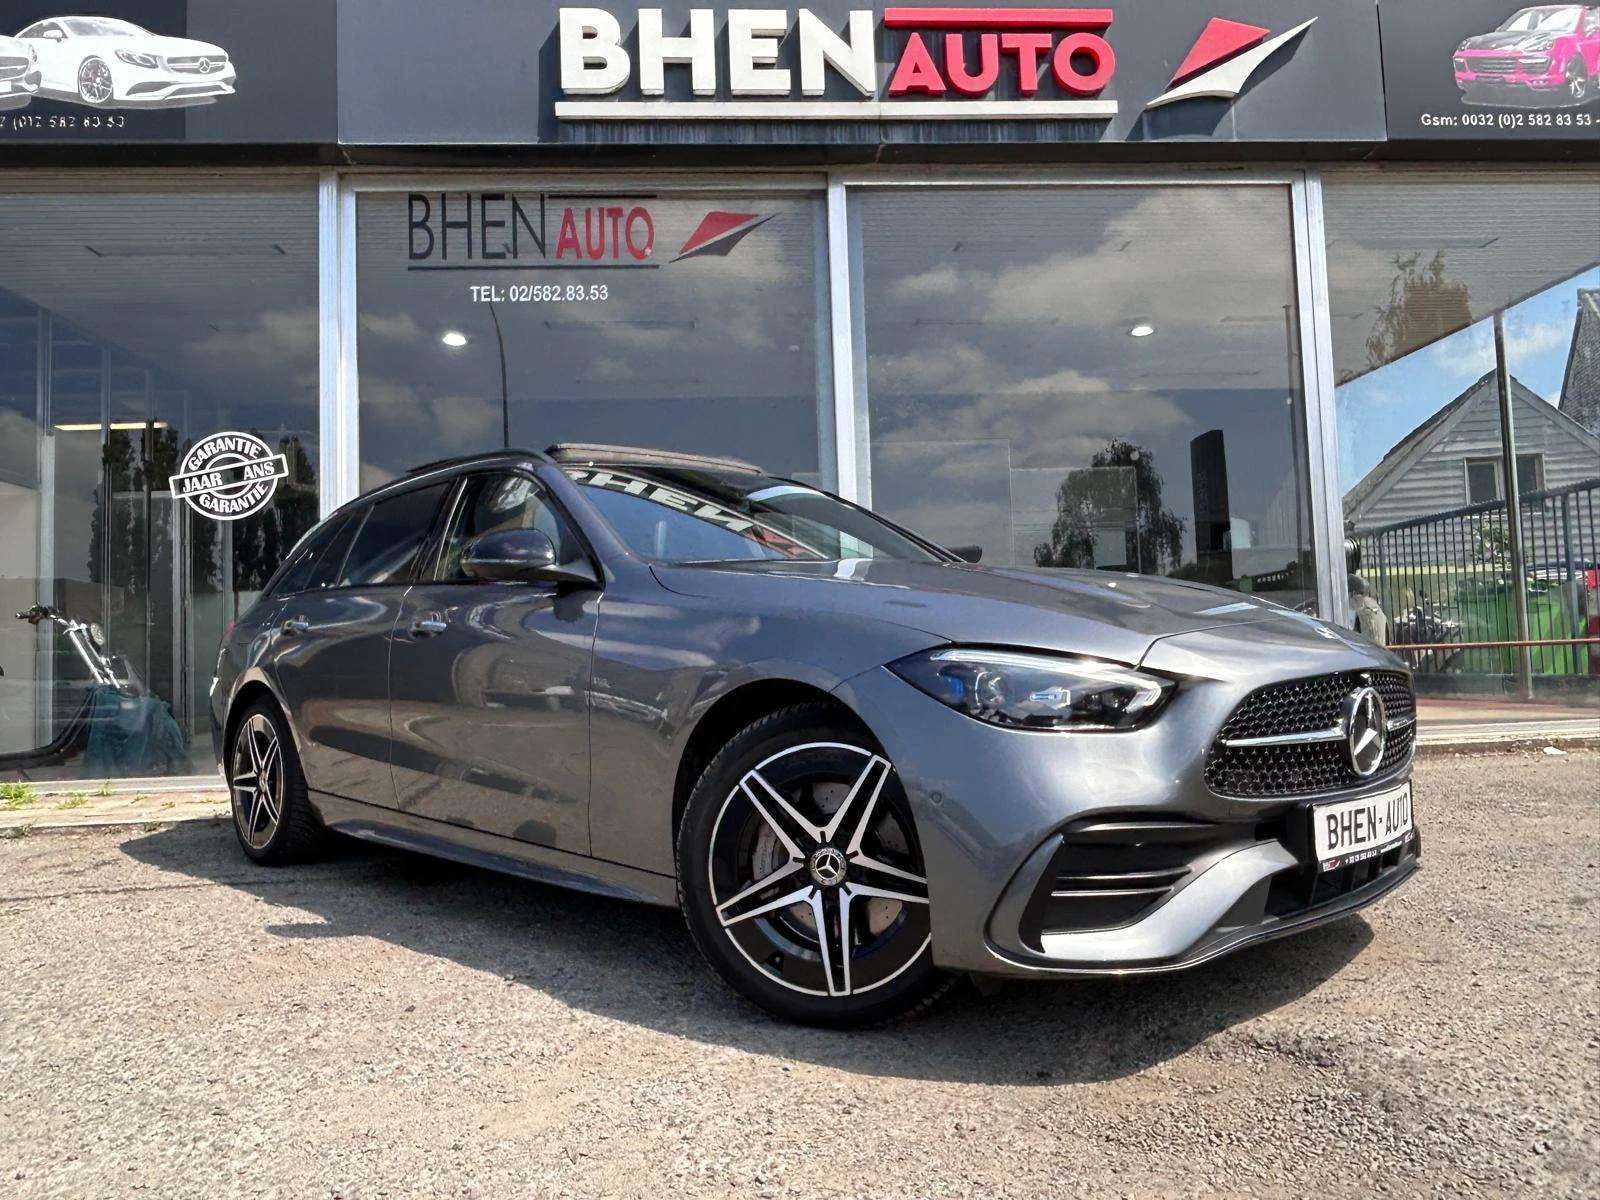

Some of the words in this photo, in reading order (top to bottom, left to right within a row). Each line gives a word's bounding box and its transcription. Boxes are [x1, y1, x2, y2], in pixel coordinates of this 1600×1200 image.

[558, 7, 877, 98] BHEN
[888, 31, 1117, 97] AUTO
[49, 115, 76, 128] 582
[106, 115, 125, 128] 53
[1420, 113, 1458, 126] Gsm:
[1461, 114, 1494, 126] 0032
[1499, 113, 1524, 129] (0)2
[1528, 113, 1551, 126] 582
[1556, 113, 1571, 126] 83
[1576, 113, 1591, 126] 53
[408, 192, 546, 260] BHEN
[556, 206, 655, 261] AUTO
[470, 286, 505, 302] TEL:
[509, 285, 609, 301] 02/582.83.53
[187, 437, 262, 471] GARANTIE
[182, 472, 223, 493] JAAR
[243, 461, 275, 481] ANS
[199, 482, 269, 513] GARANTIE
